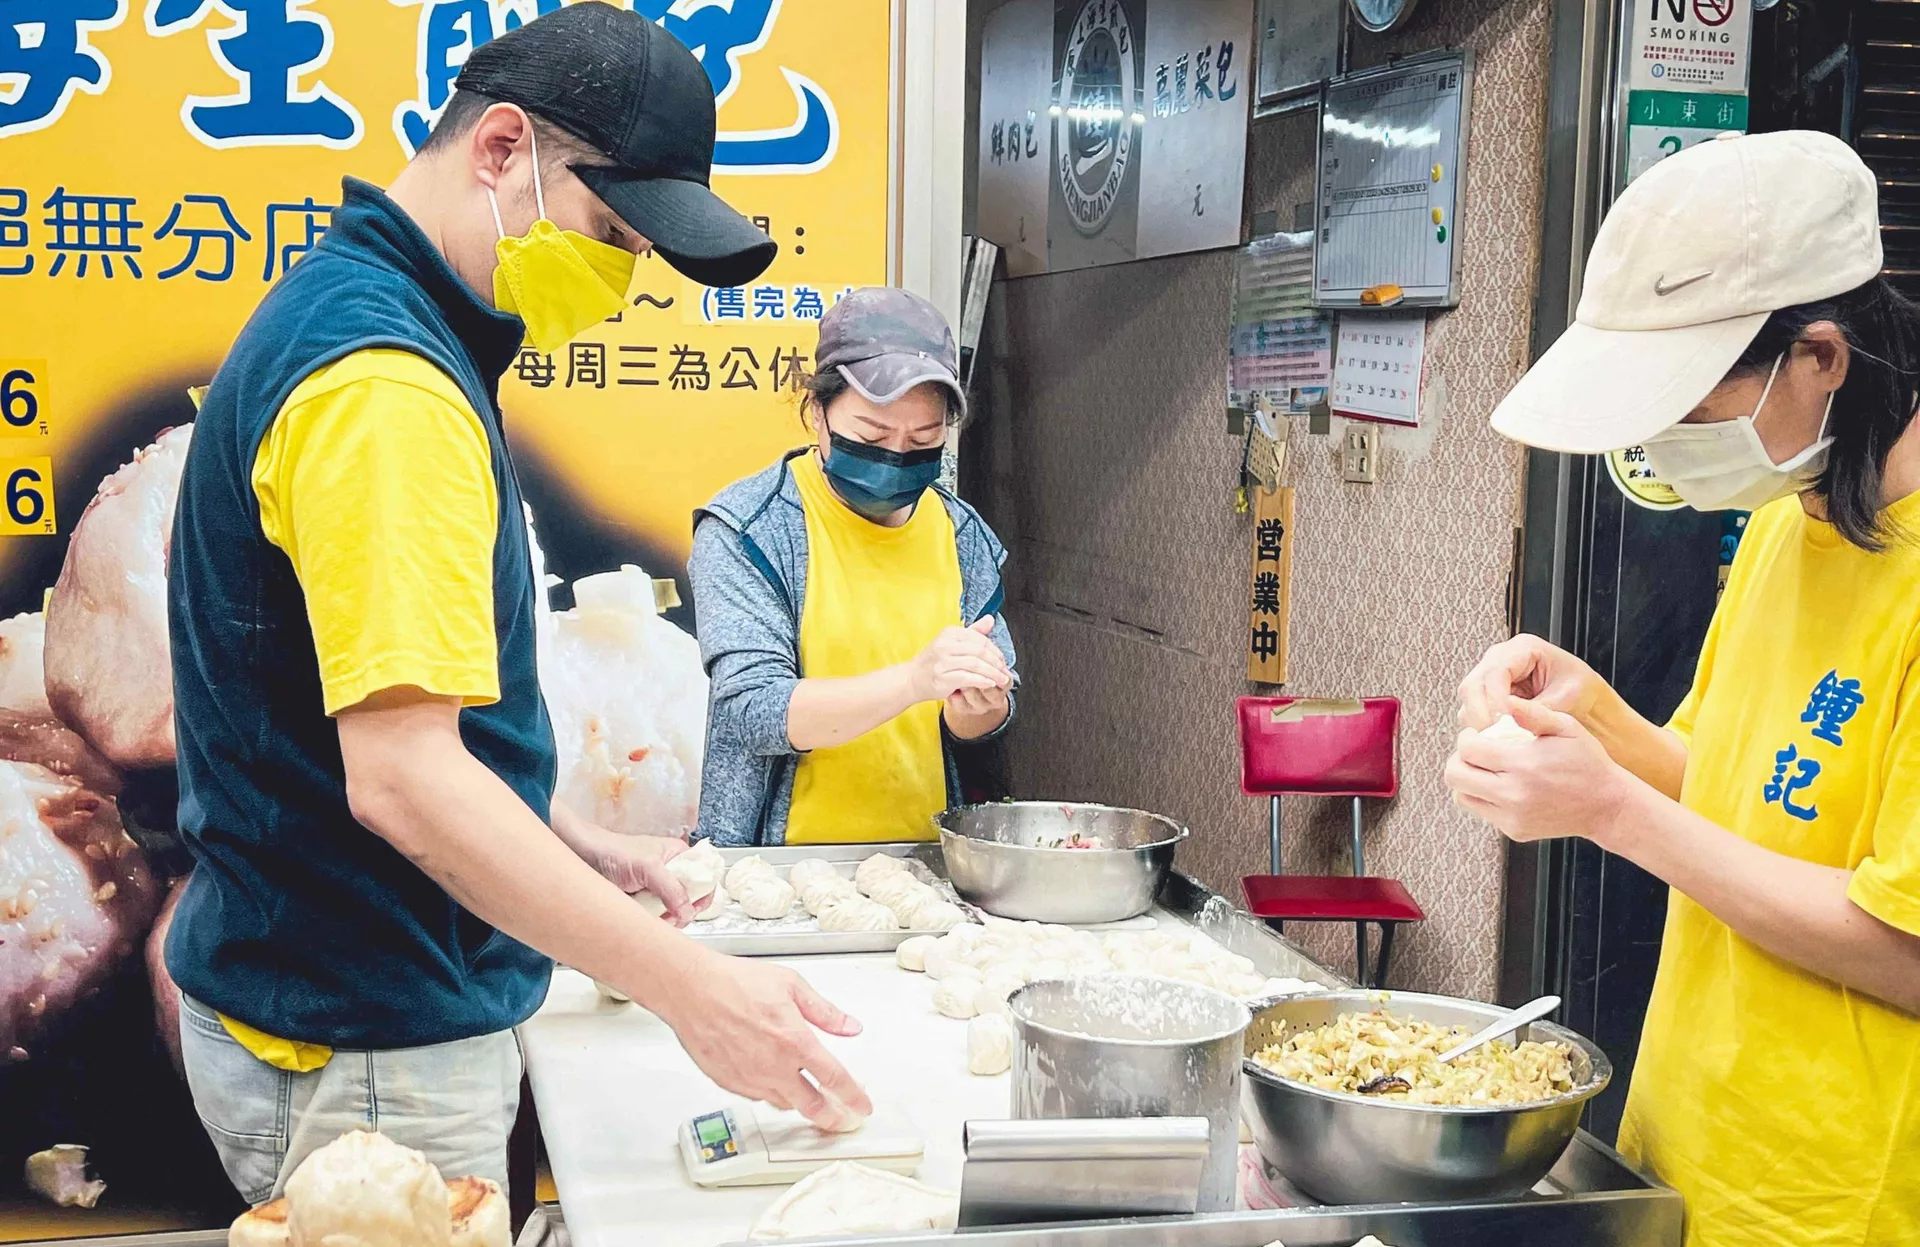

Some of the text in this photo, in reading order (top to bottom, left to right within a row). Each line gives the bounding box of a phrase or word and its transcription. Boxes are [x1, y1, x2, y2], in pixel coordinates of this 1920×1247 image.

[1650, 27, 1731, 44] SMOKING
[1643, 98, 1734, 125] 小東街
[1251, 518, 1285, 664] 営業中
[1763, 669, 1865, 821] 鍾記
